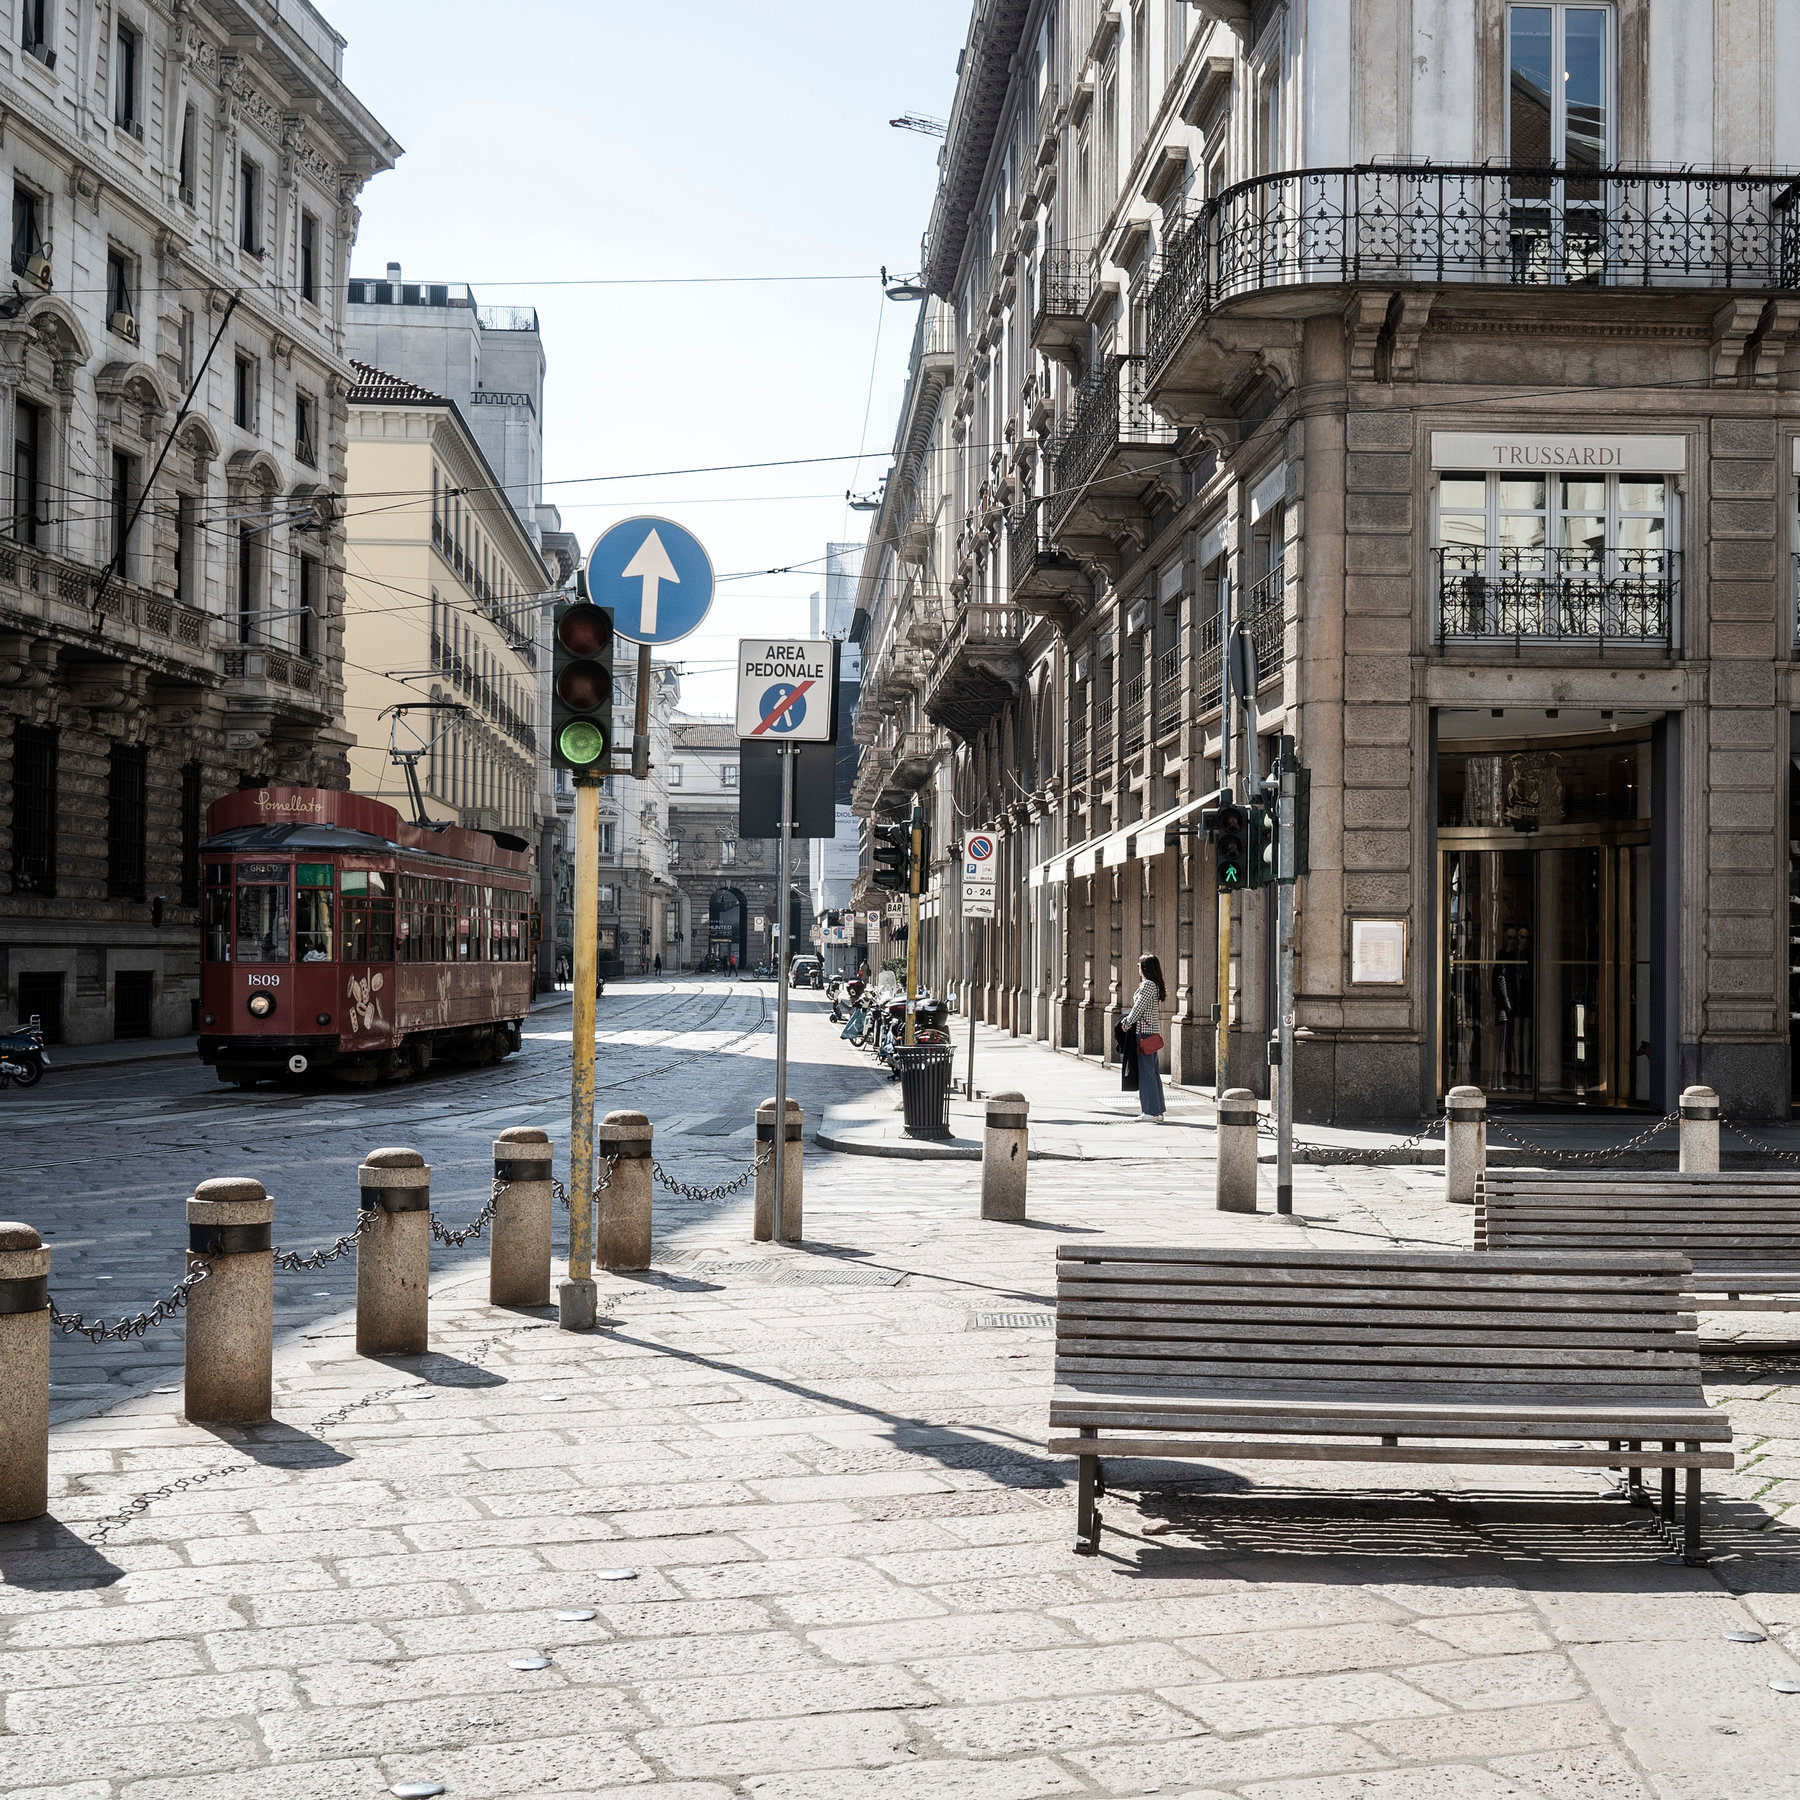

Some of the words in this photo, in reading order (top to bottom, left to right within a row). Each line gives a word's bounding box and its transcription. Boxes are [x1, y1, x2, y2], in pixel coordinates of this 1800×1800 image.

[1492, 445, 1623, 466] TRUSSARDI
[765, 645, 806, 661] AREA
[745, 662, 824, 679] PEDONALE
[253, 790, 324, 813] Pomellato
[249, 864, 279, 873] GRECO
[966, 887, 973, 895] 0
[979, 887, 992, 896] 24
[887, 903, 902, 913] BAR
[248, 973, 280, 987] 1809
